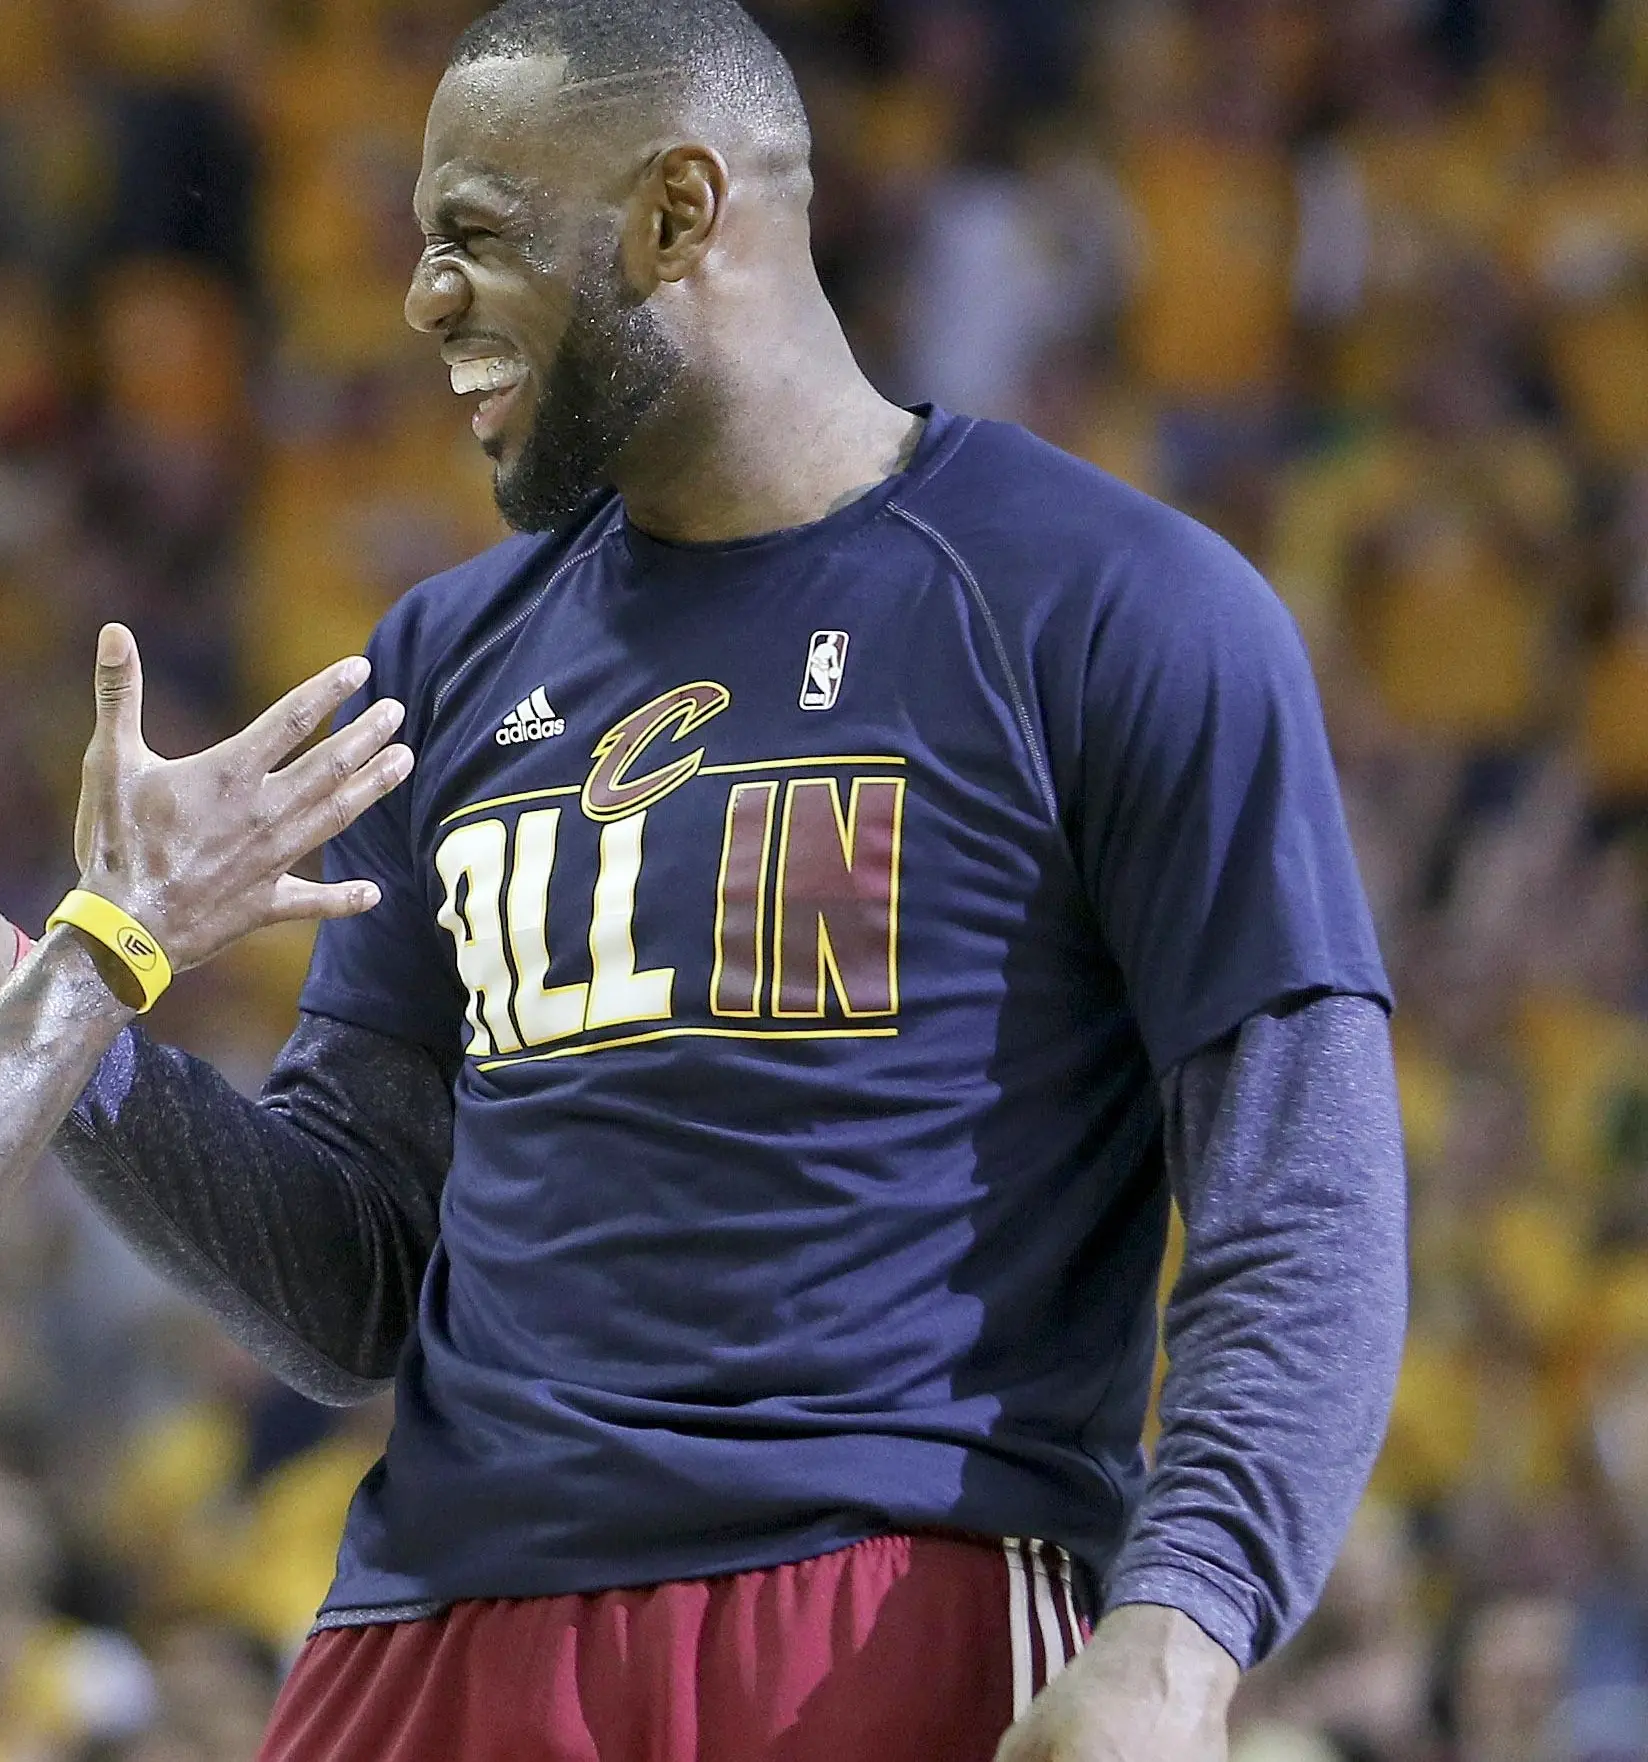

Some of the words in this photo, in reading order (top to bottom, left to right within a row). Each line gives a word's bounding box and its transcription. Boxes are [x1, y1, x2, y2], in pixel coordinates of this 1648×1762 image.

[495, 717, 566, 746] adidas
[581, 680, 730, 821] C
[435, 807, 676, 1057] ALL
[710, 776, 907, 1019] IN
